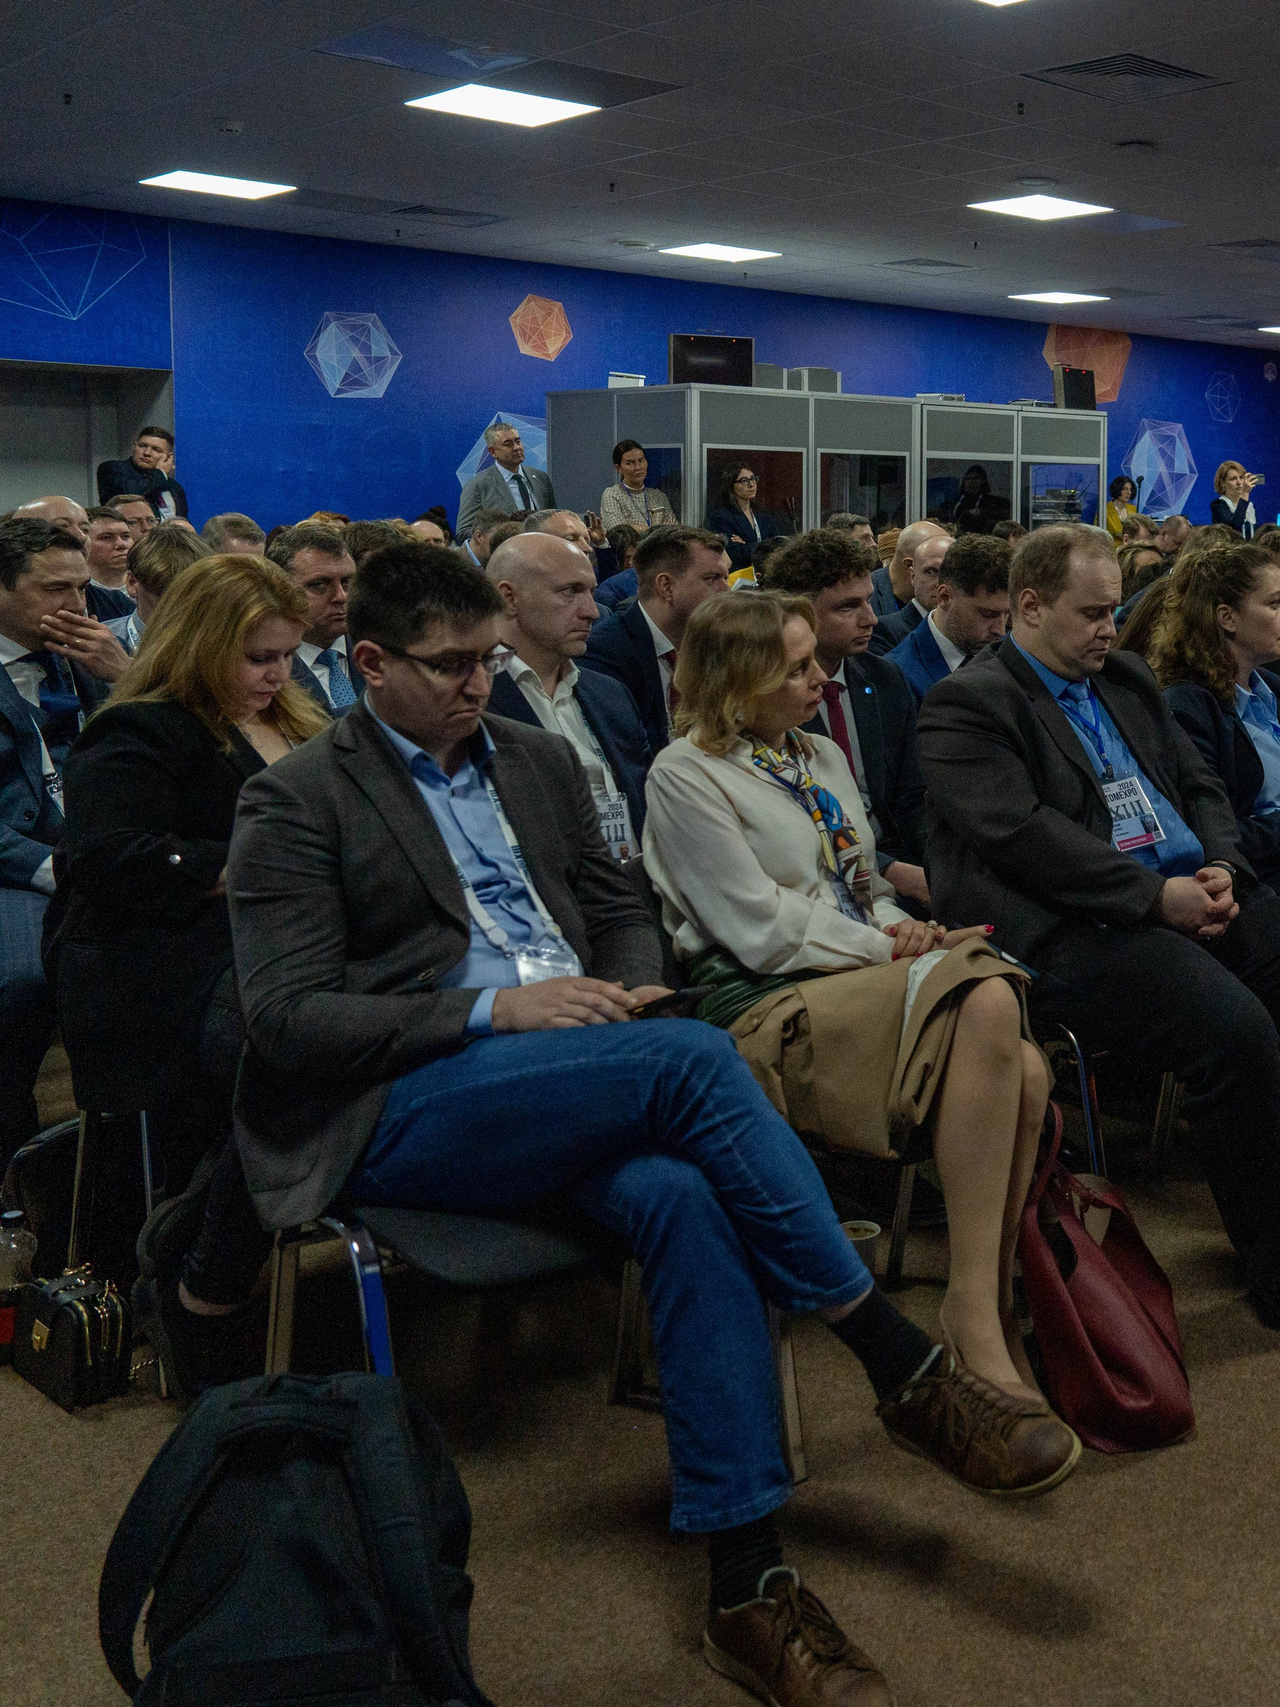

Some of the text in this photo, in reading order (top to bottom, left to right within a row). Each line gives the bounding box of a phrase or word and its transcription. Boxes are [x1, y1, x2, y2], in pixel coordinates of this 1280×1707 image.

[1117, 780, 1134, 791] 2024
[1105, 787, 1138, 803] TOMEXPO
[607, 803, 624, 811] 2024
[600, 810, 625, 820] MEXPO
